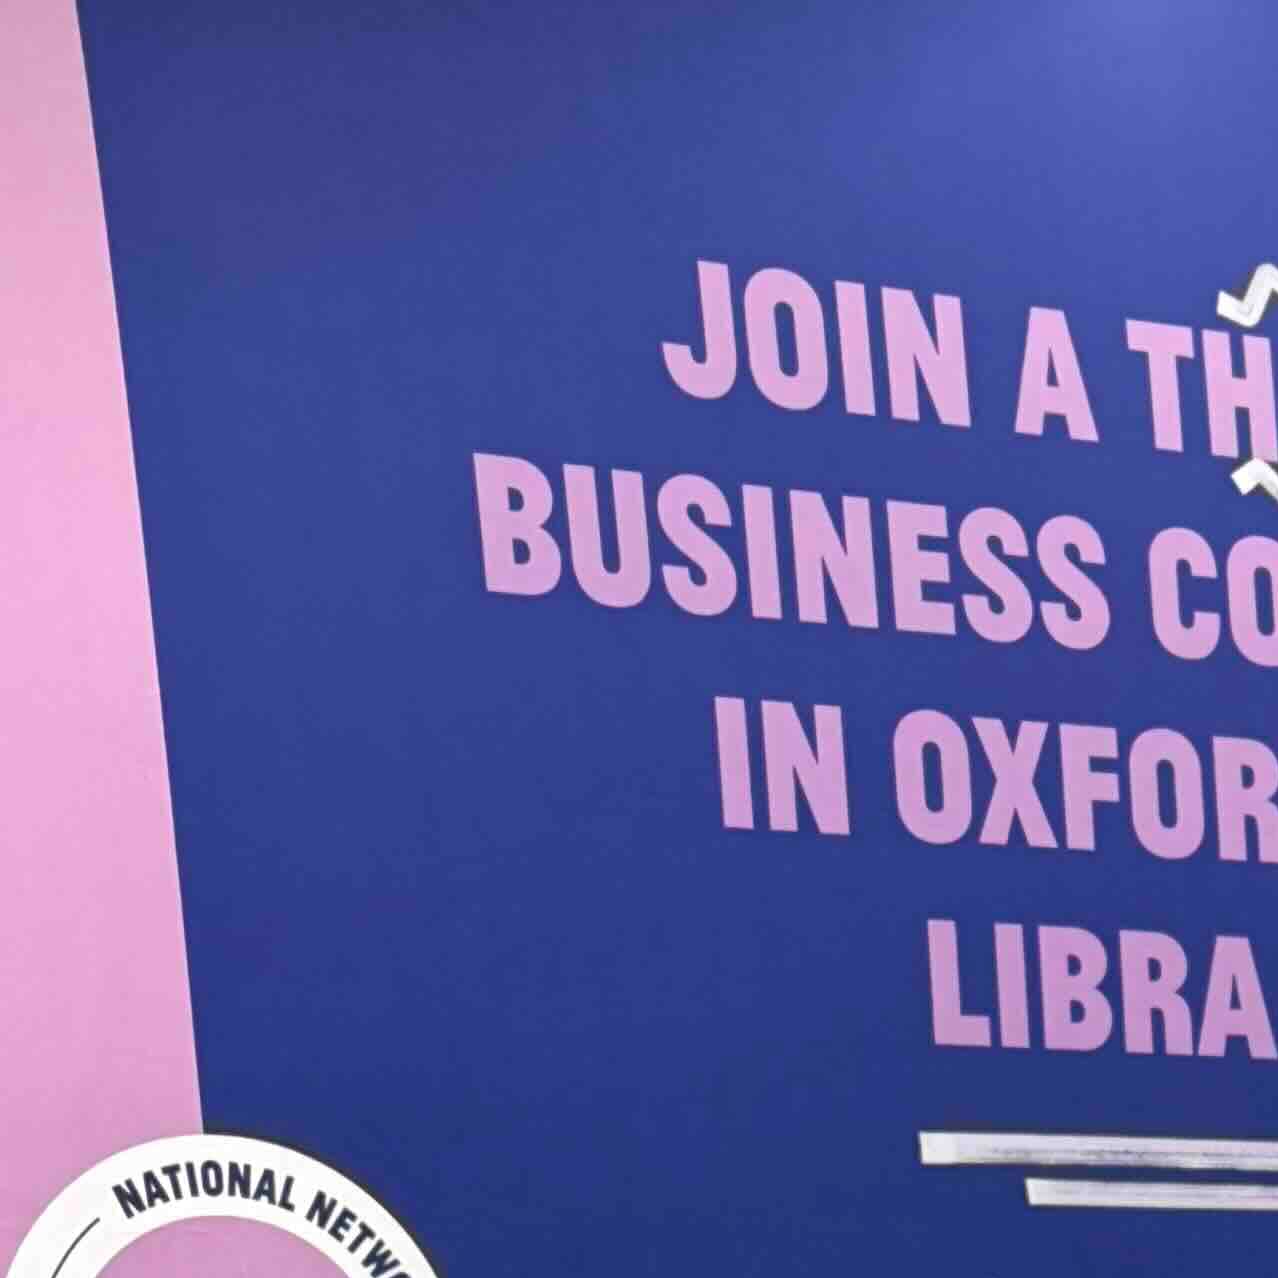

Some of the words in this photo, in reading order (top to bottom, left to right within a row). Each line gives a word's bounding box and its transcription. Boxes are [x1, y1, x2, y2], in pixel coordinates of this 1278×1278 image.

[663, 261, 974, 427] JOIN
[1016, 307, 1098, 441] A
[473, 453, 1110, 649] BUSINESS
[715, 696, 849, 834] IN
[112, 1160, 296, 1219] NATIONAL
